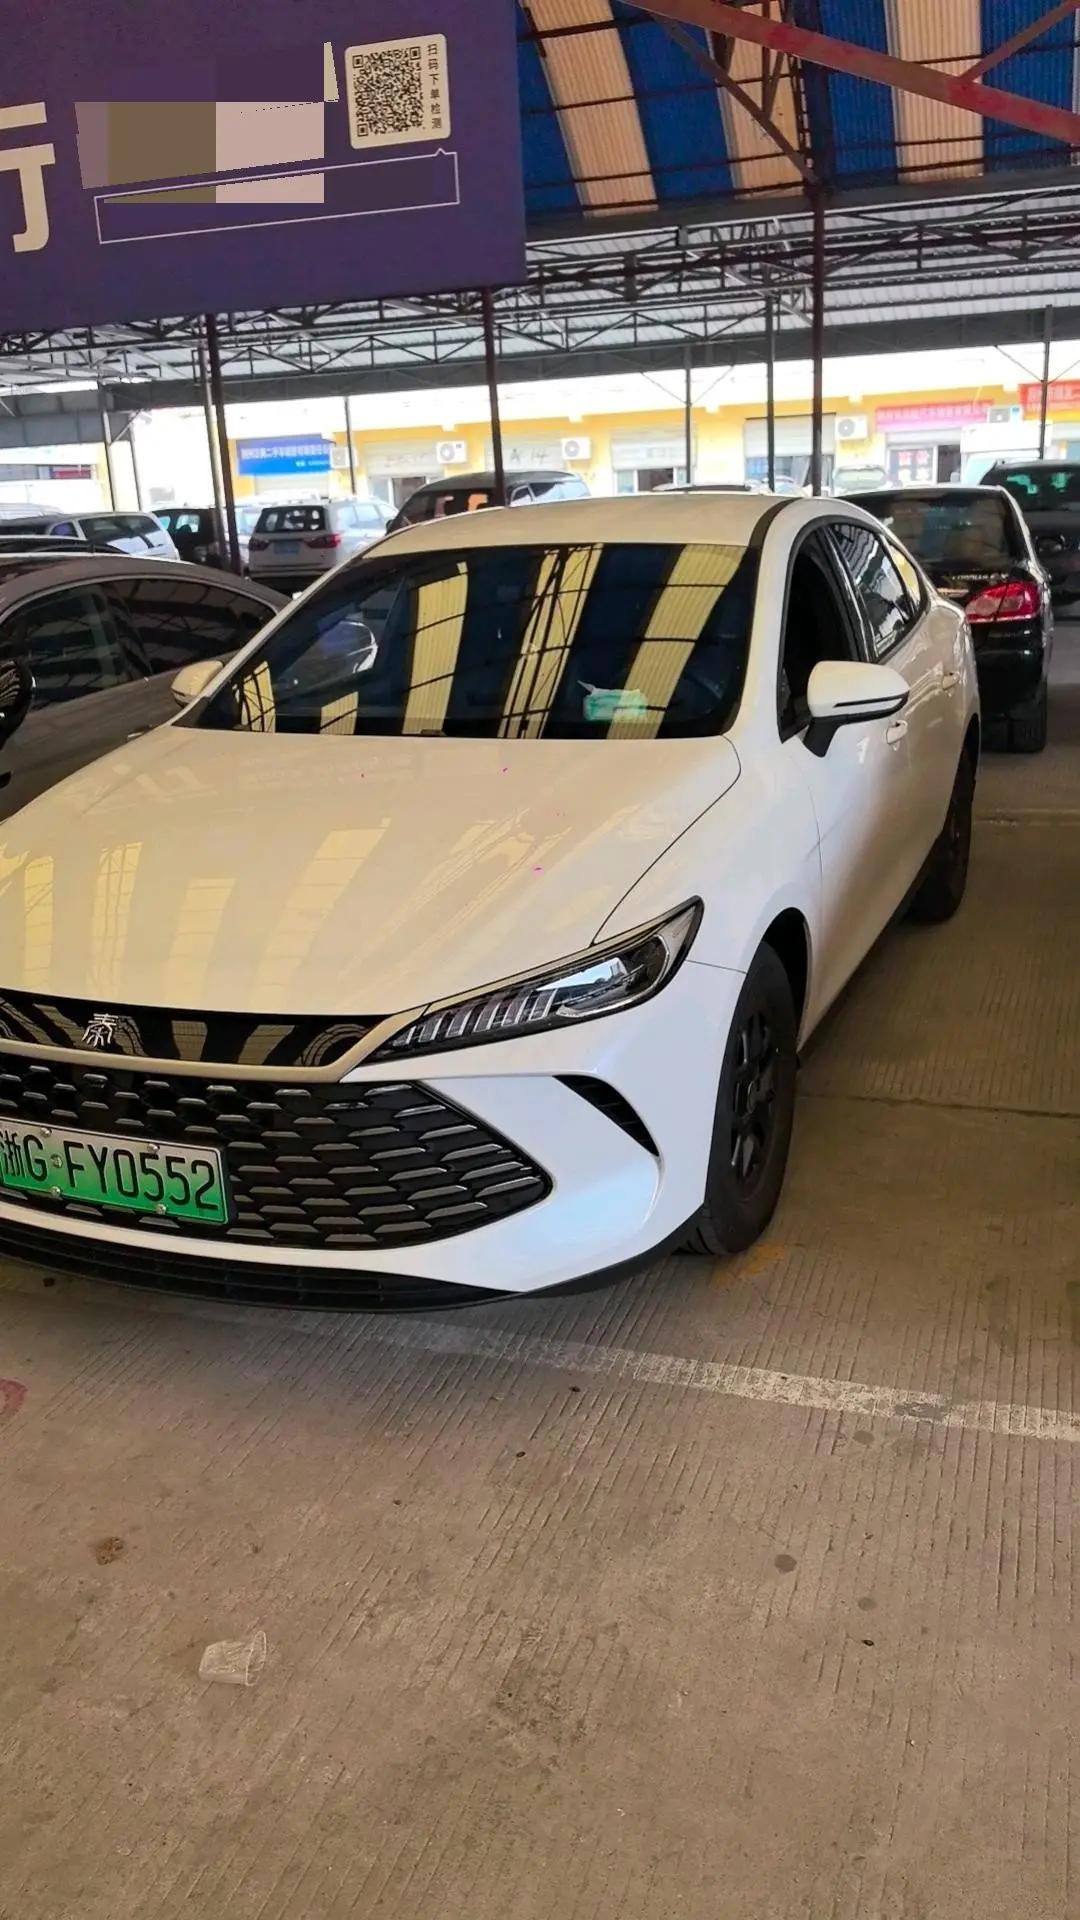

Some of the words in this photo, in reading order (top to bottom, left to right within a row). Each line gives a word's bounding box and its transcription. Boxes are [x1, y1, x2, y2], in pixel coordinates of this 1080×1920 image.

[427, 43, 443, 129] 扫码下单检测
